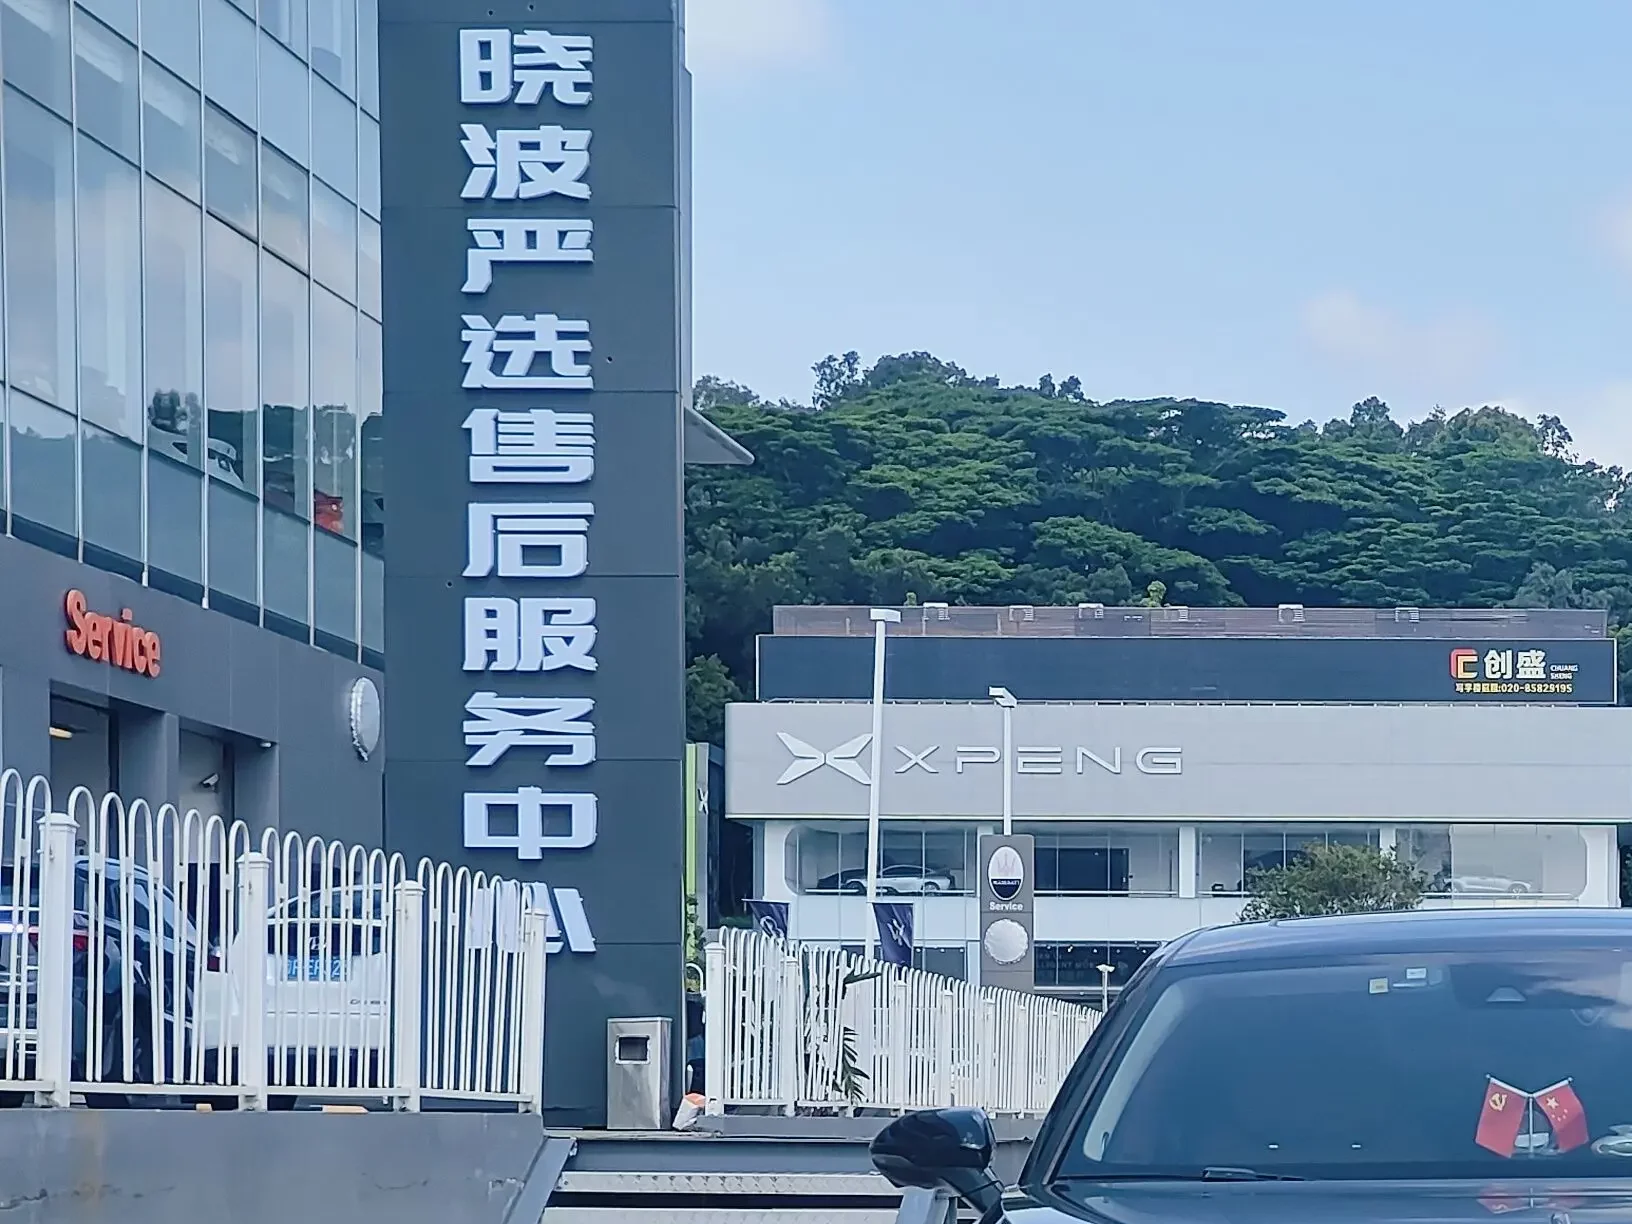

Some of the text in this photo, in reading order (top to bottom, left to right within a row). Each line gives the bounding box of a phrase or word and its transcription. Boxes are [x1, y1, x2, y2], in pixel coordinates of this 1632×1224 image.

[459, 28, 599, 953] 晓波严选售后服务中心
[65, 588, 162, 678] Service
[1483, 649, 1547, 680] 创盛
[894, 744, 1183, 775] XPENG
[989, 901, 1024, 912] Service
